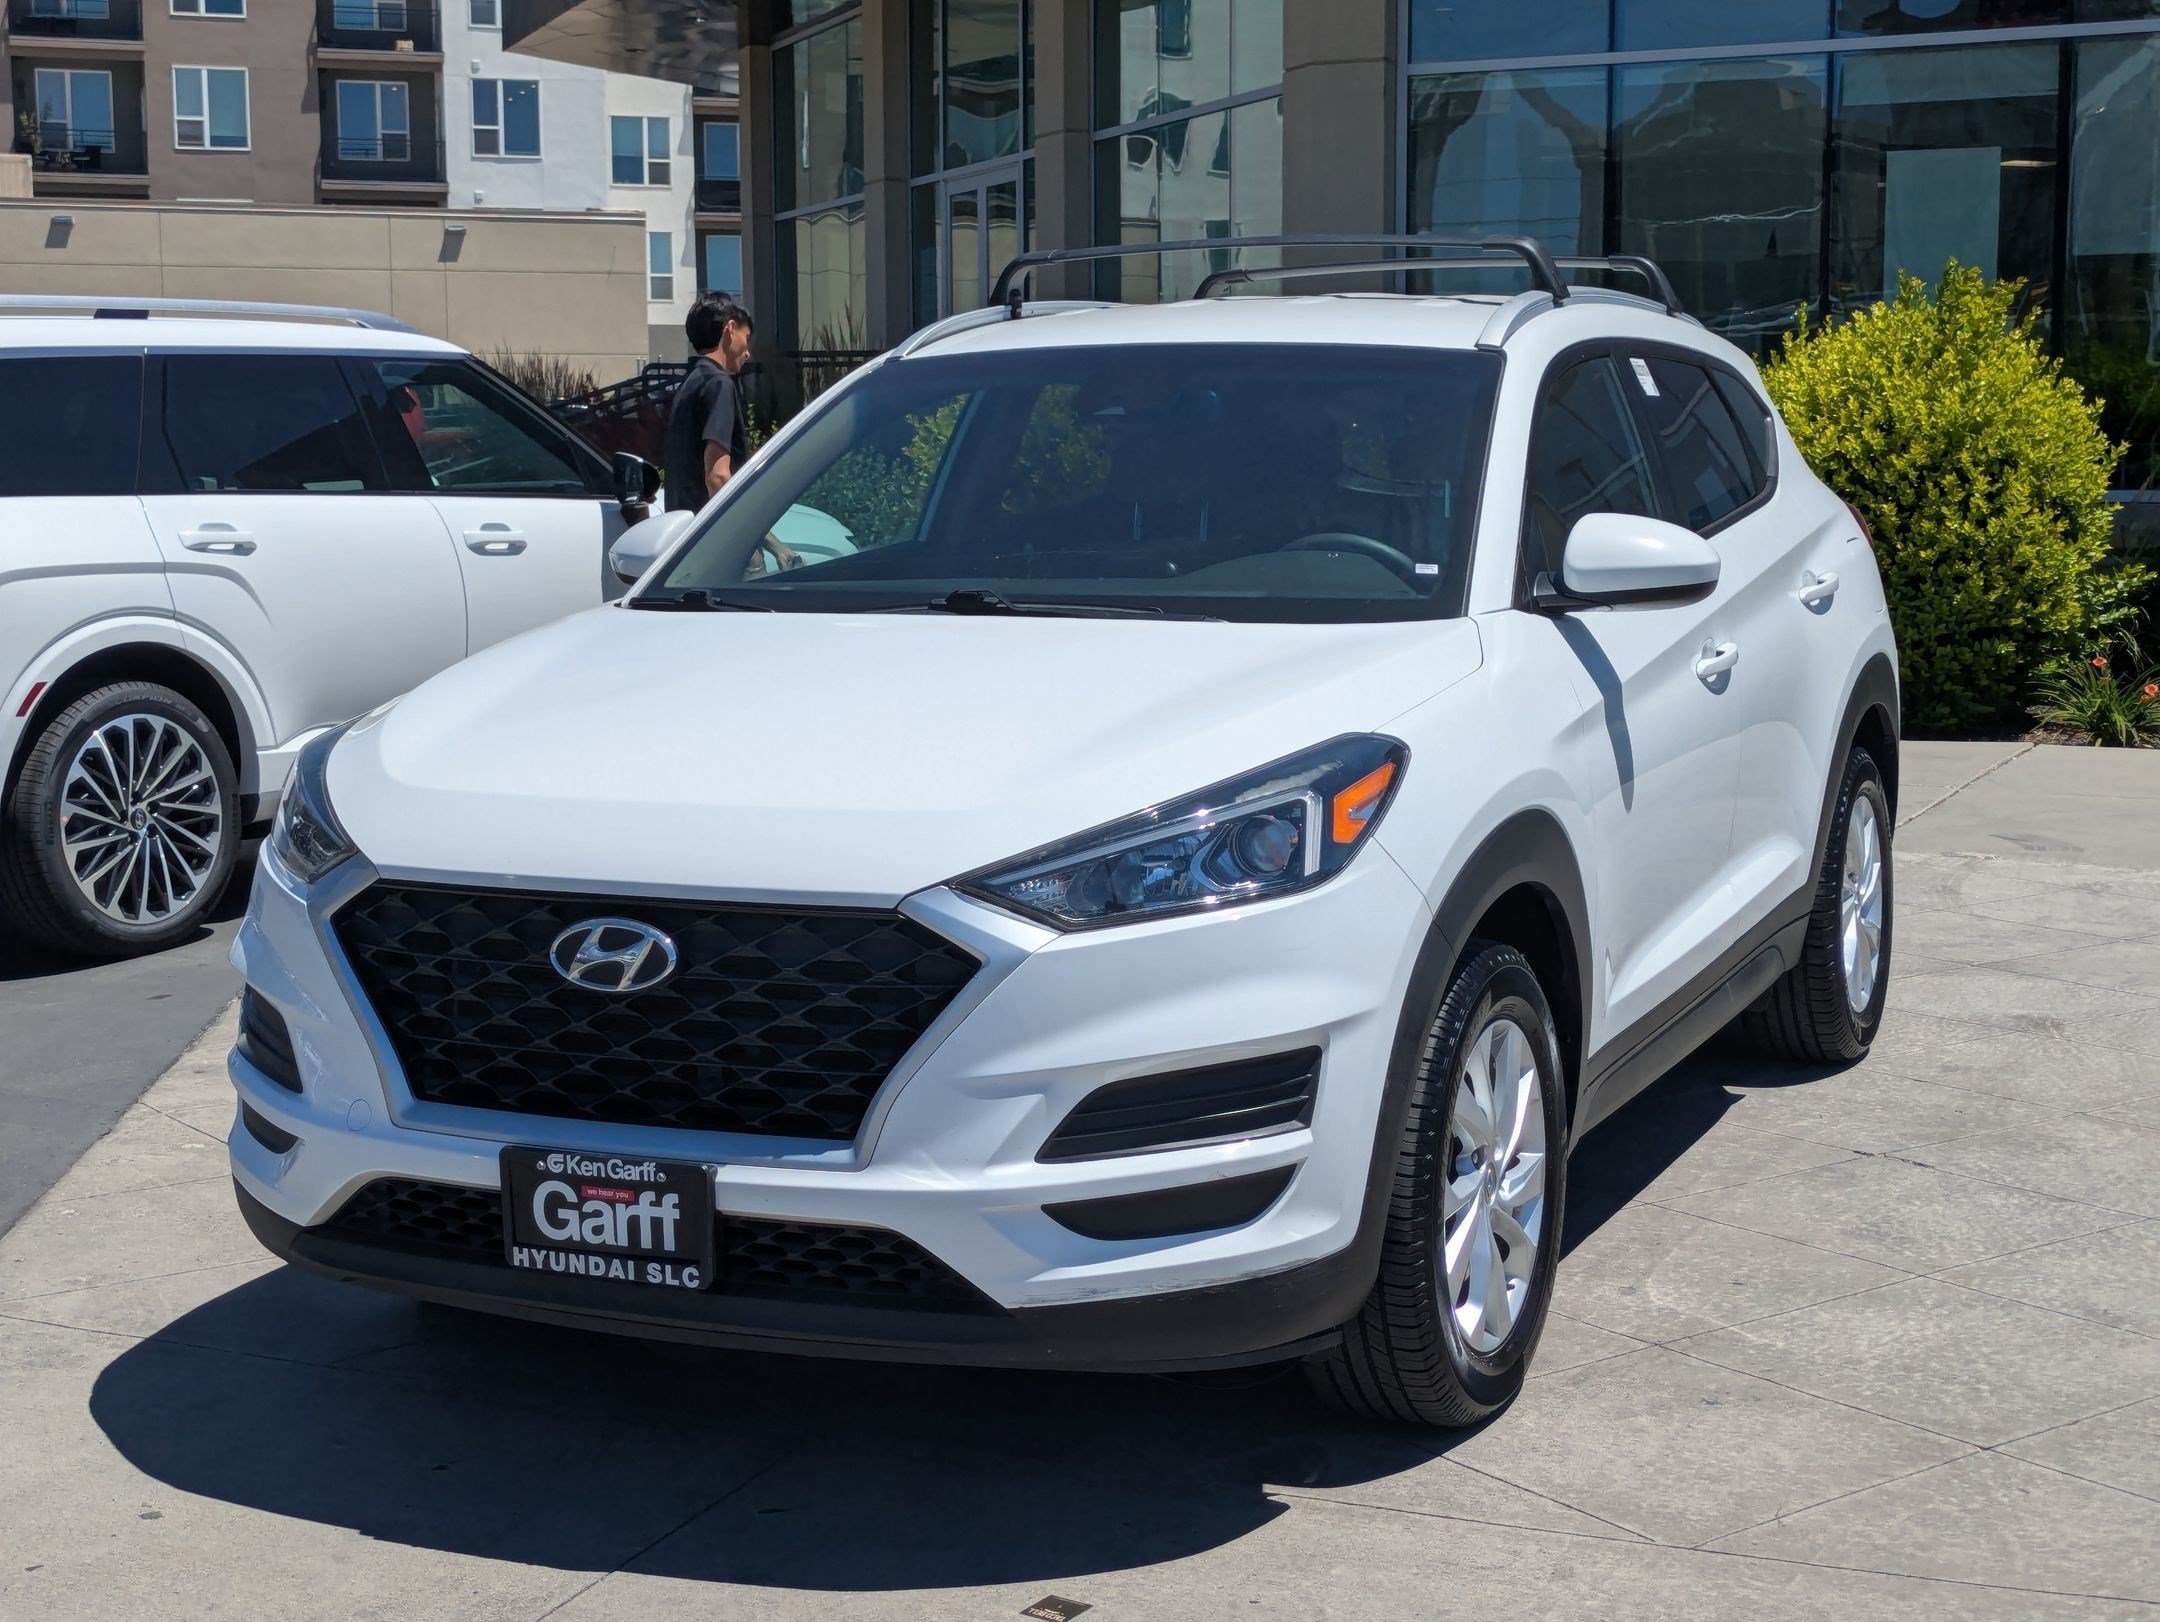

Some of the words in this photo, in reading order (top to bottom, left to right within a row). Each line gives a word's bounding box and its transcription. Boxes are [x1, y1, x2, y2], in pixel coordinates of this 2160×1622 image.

[566, 1154, 606, 1178] Ken
[606, 1158, 656, 1182] Garff
[587, 1188, 598, 1196] we
[598, 1188, 614, 1197] hear
[615, 1191, 629, 1199] you
[532, 1180, 681, 1251] Garff
[512, 1246, 635, 1281] HYUNDAI
[646, 1262, 700, 1289] SLC
